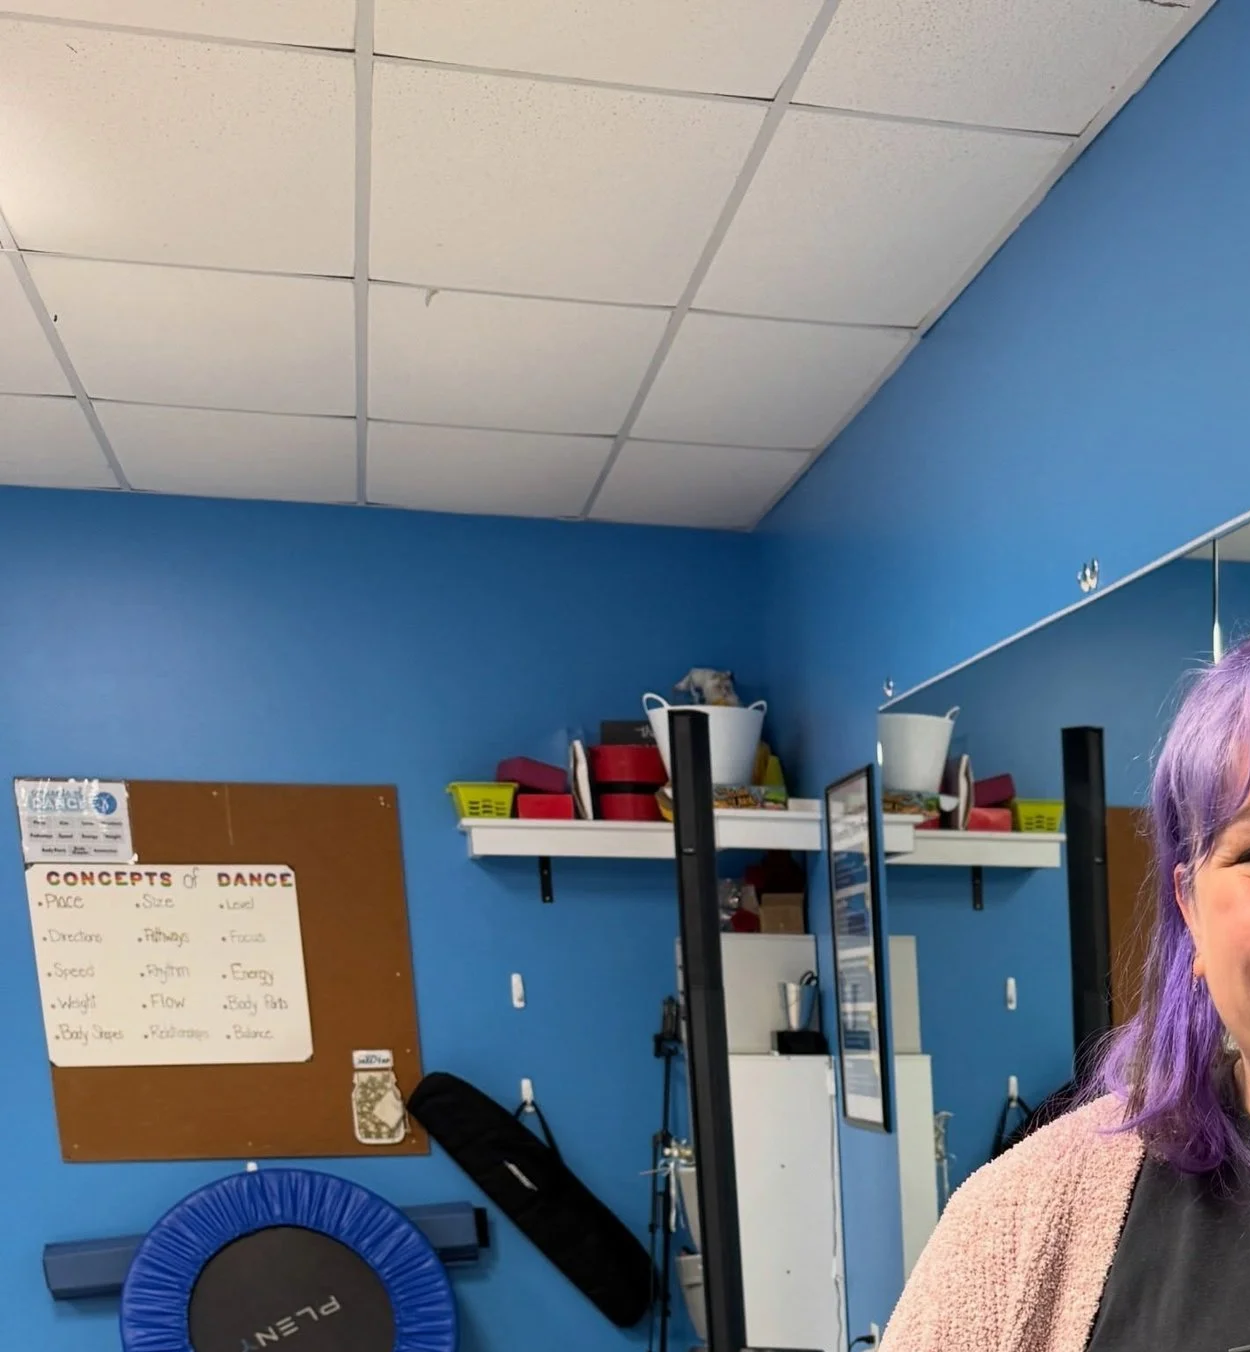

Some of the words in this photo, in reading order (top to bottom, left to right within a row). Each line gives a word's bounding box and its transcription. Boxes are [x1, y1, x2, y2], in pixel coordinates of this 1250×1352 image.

[46, 871, 173, 887] CONCEPTS
[217, 872, 293, 888] DANCE
[44, 893, 84, 909] Place
[142, 893, 175, 909] Size
[226, 898, 254, 910] Level
[229, 930, 267, 943] Focus
[54, 962, 95, 981] Speed
[230, 962, 274, 987] Energy
[150, 993, 186, 1008] Flow
[226, 994, 258, 1017] Body
[58, 1023, 88, 1047] Body
